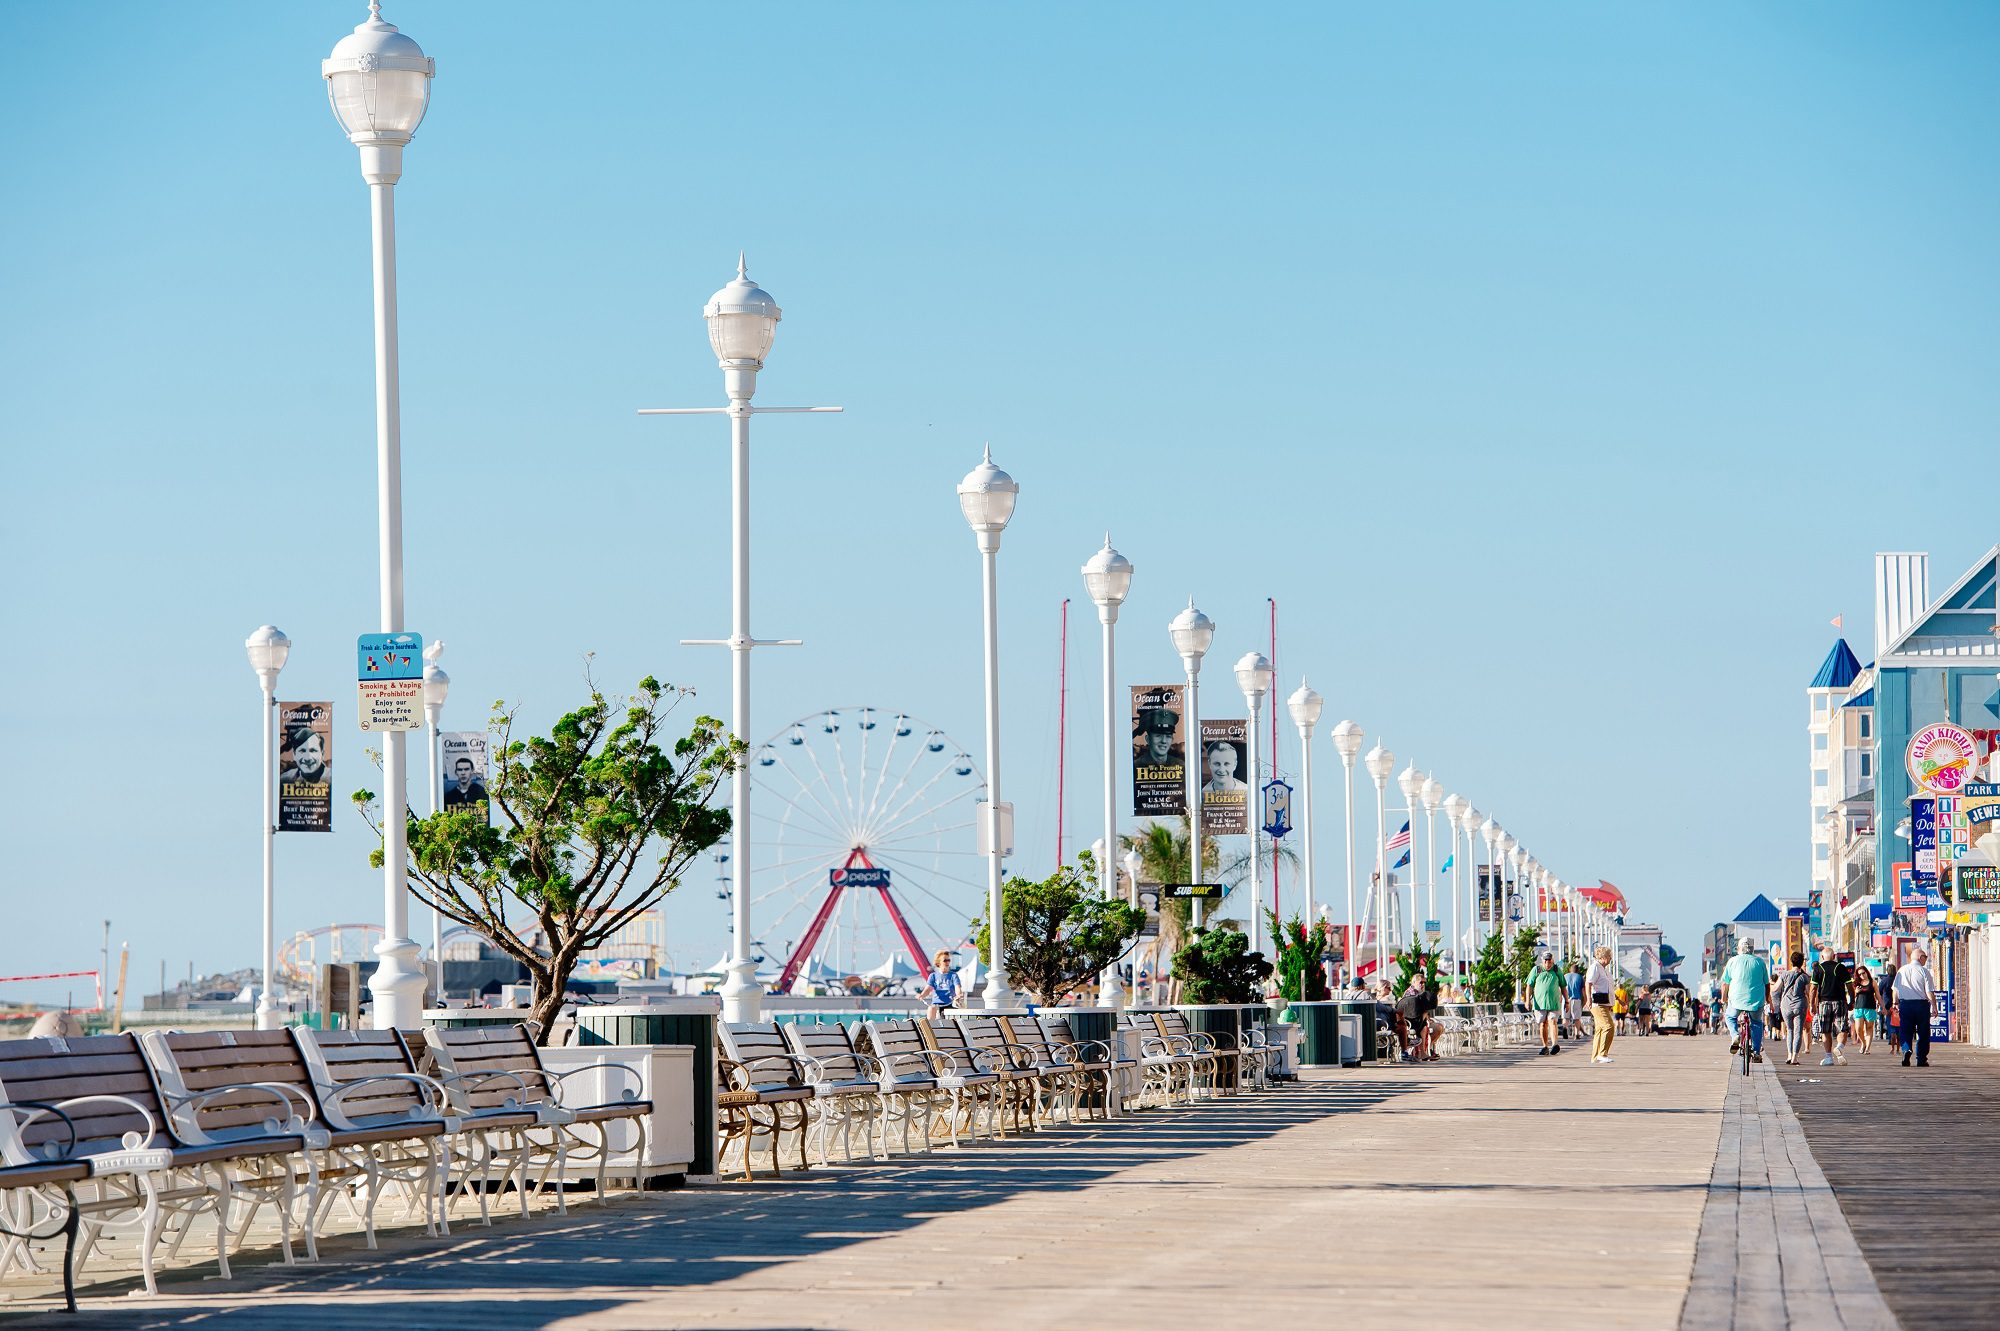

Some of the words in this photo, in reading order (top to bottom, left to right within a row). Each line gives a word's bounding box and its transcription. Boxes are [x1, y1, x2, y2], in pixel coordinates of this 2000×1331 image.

[379, 690, 416, 698] Prohibited!
[1134, 694, 1160, 704] Ocean
[1163, 692, 1182, 705] City
[282, 709, 309, 720] Ocean
[311, 709, 330, 722] City
[1202, 726, 1227, 735] Ocean
[1228, 725, 1246, 737] City
[444, 740, 467, 748] Ocean
[470, 738, 486, 752] City
[1913, 730, 1937, 759] CANDY
[1938, 728, 1974, 758] KITCHEN
[1136, 767, 1184, 780] Honor
[283, 784, 329, 796] Honor
[1967, 786, 1992, 795] PARK
[1205, 792, 1245, 803] Honor
[849, 871, 881, 882] pepsi
[1174, 886, 1213, 896] SUBWAY
[1930, 1028, 1948, 1038] PEN
